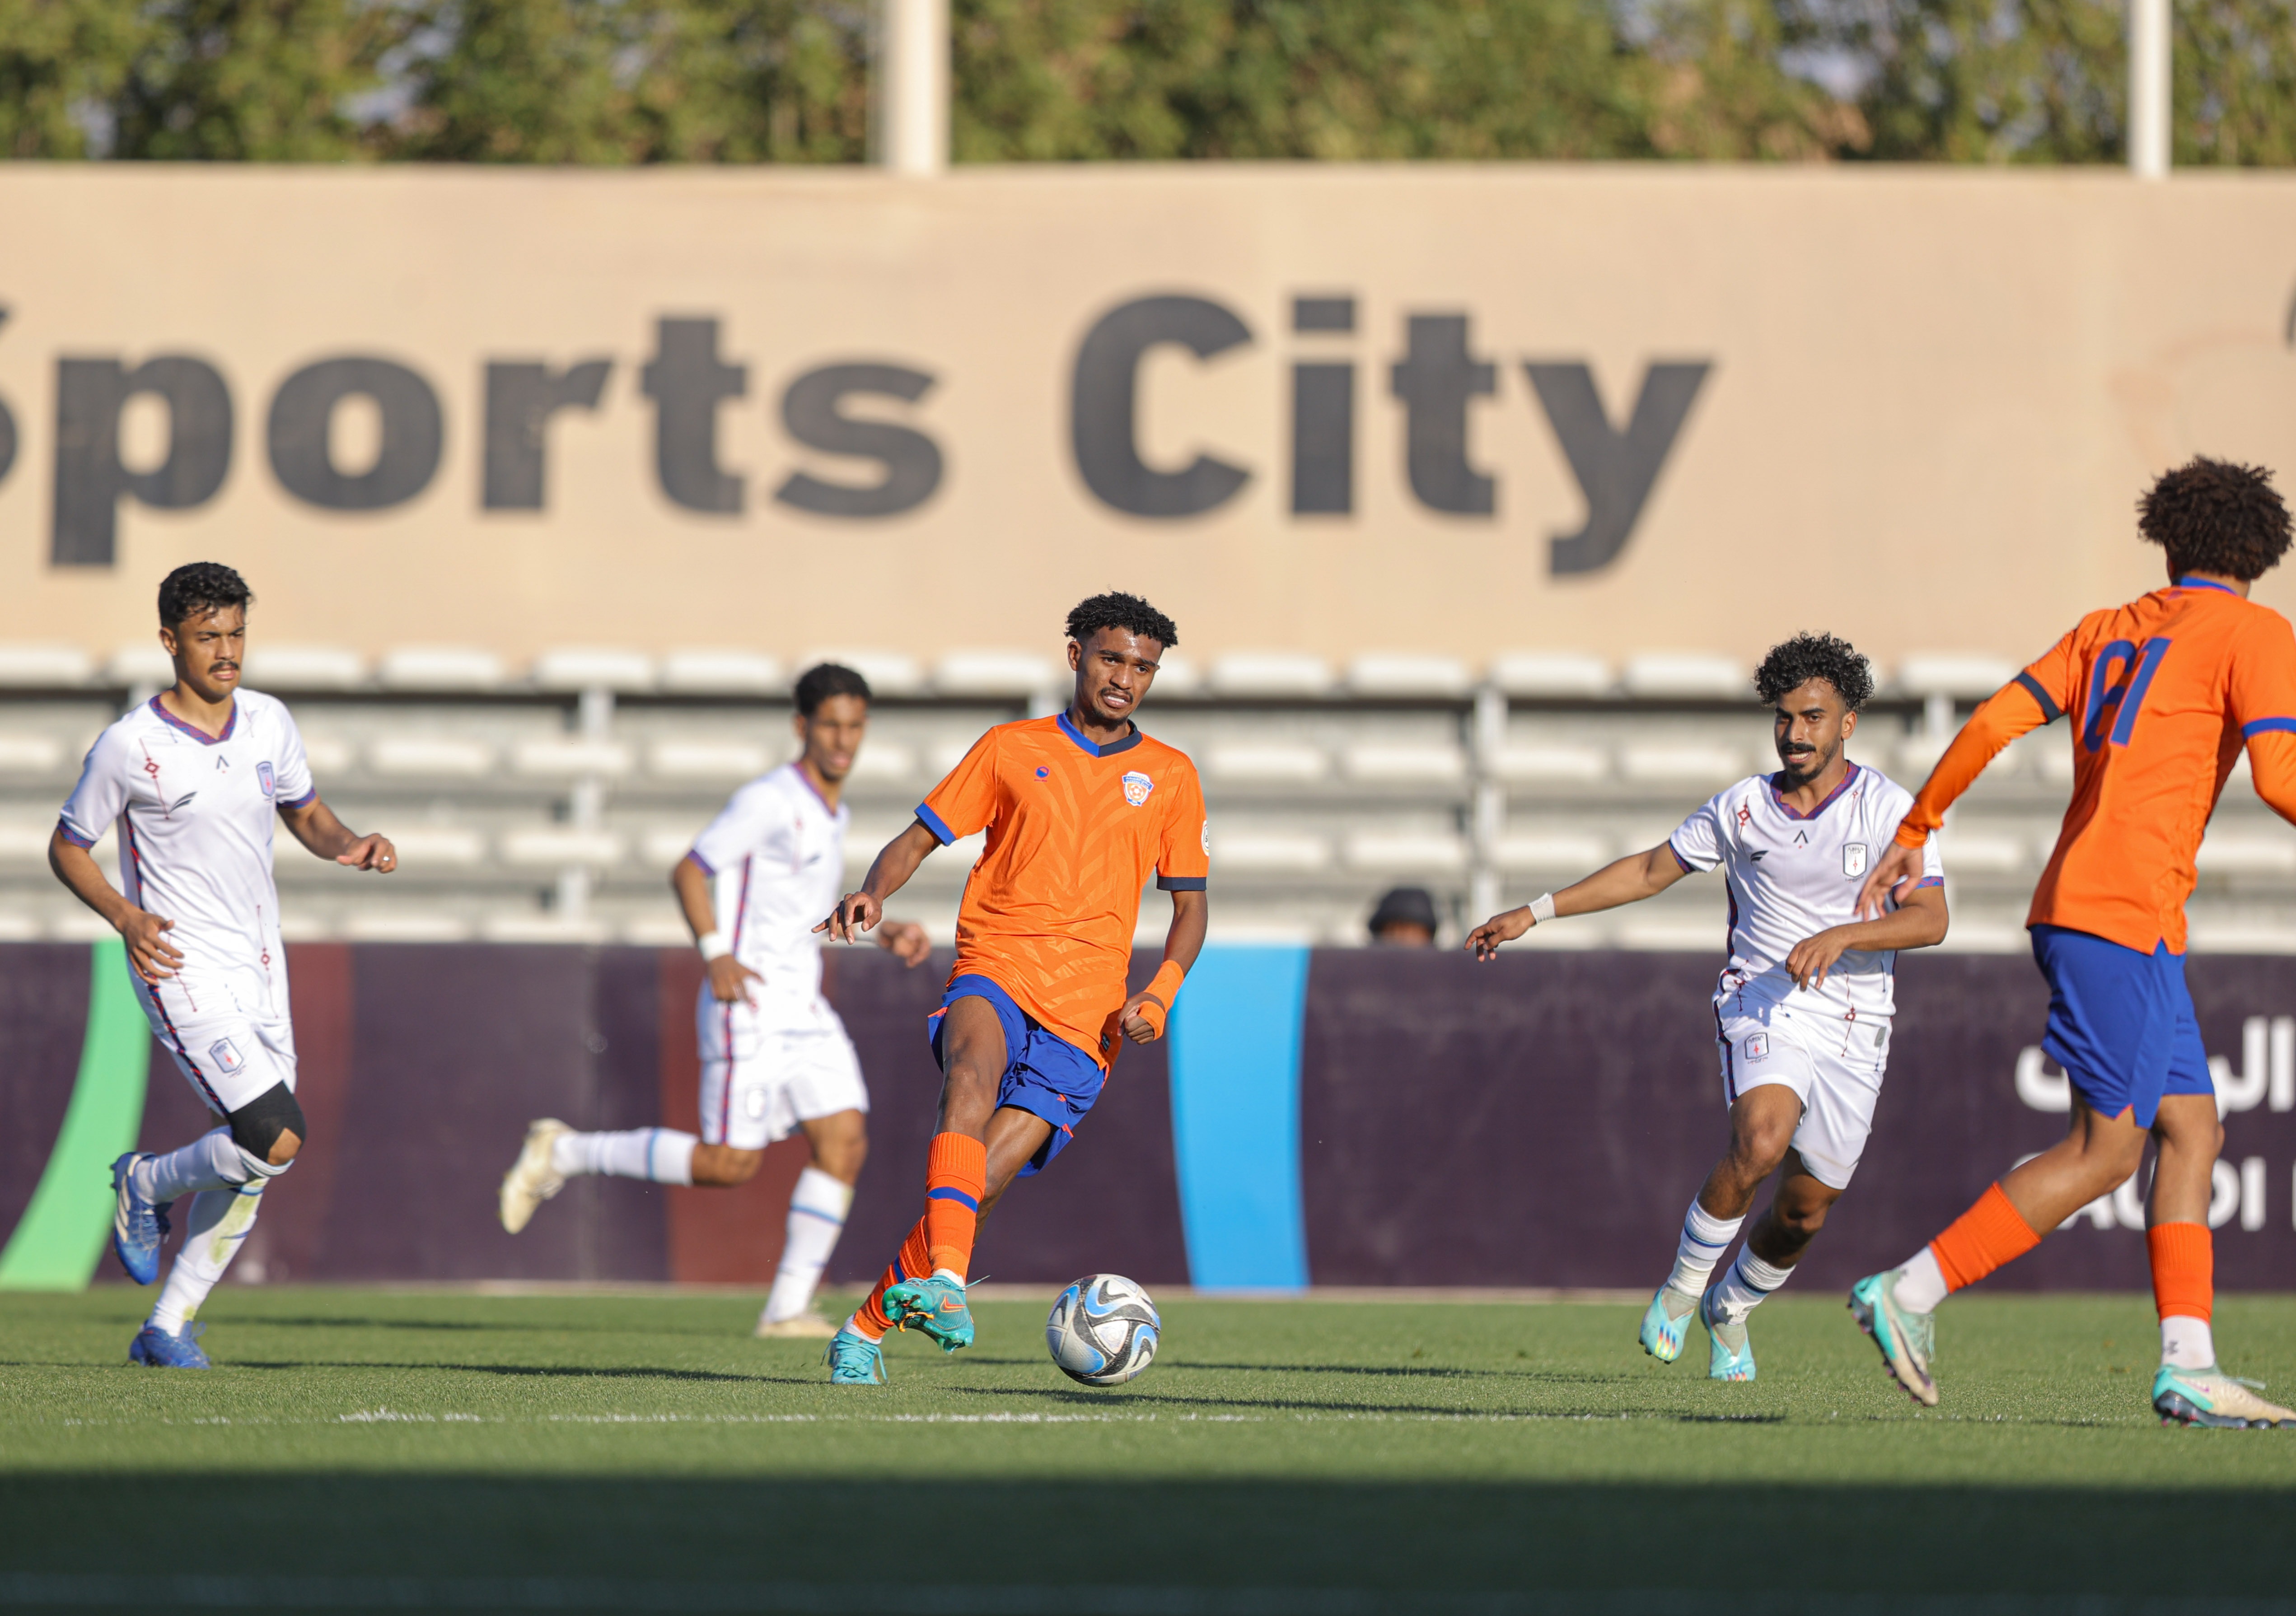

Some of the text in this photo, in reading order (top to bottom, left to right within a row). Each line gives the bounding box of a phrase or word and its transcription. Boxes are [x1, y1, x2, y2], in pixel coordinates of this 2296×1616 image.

[0, 291, 1715, 581] ports City
[2010, 1152, 2267, 1231] UDI
